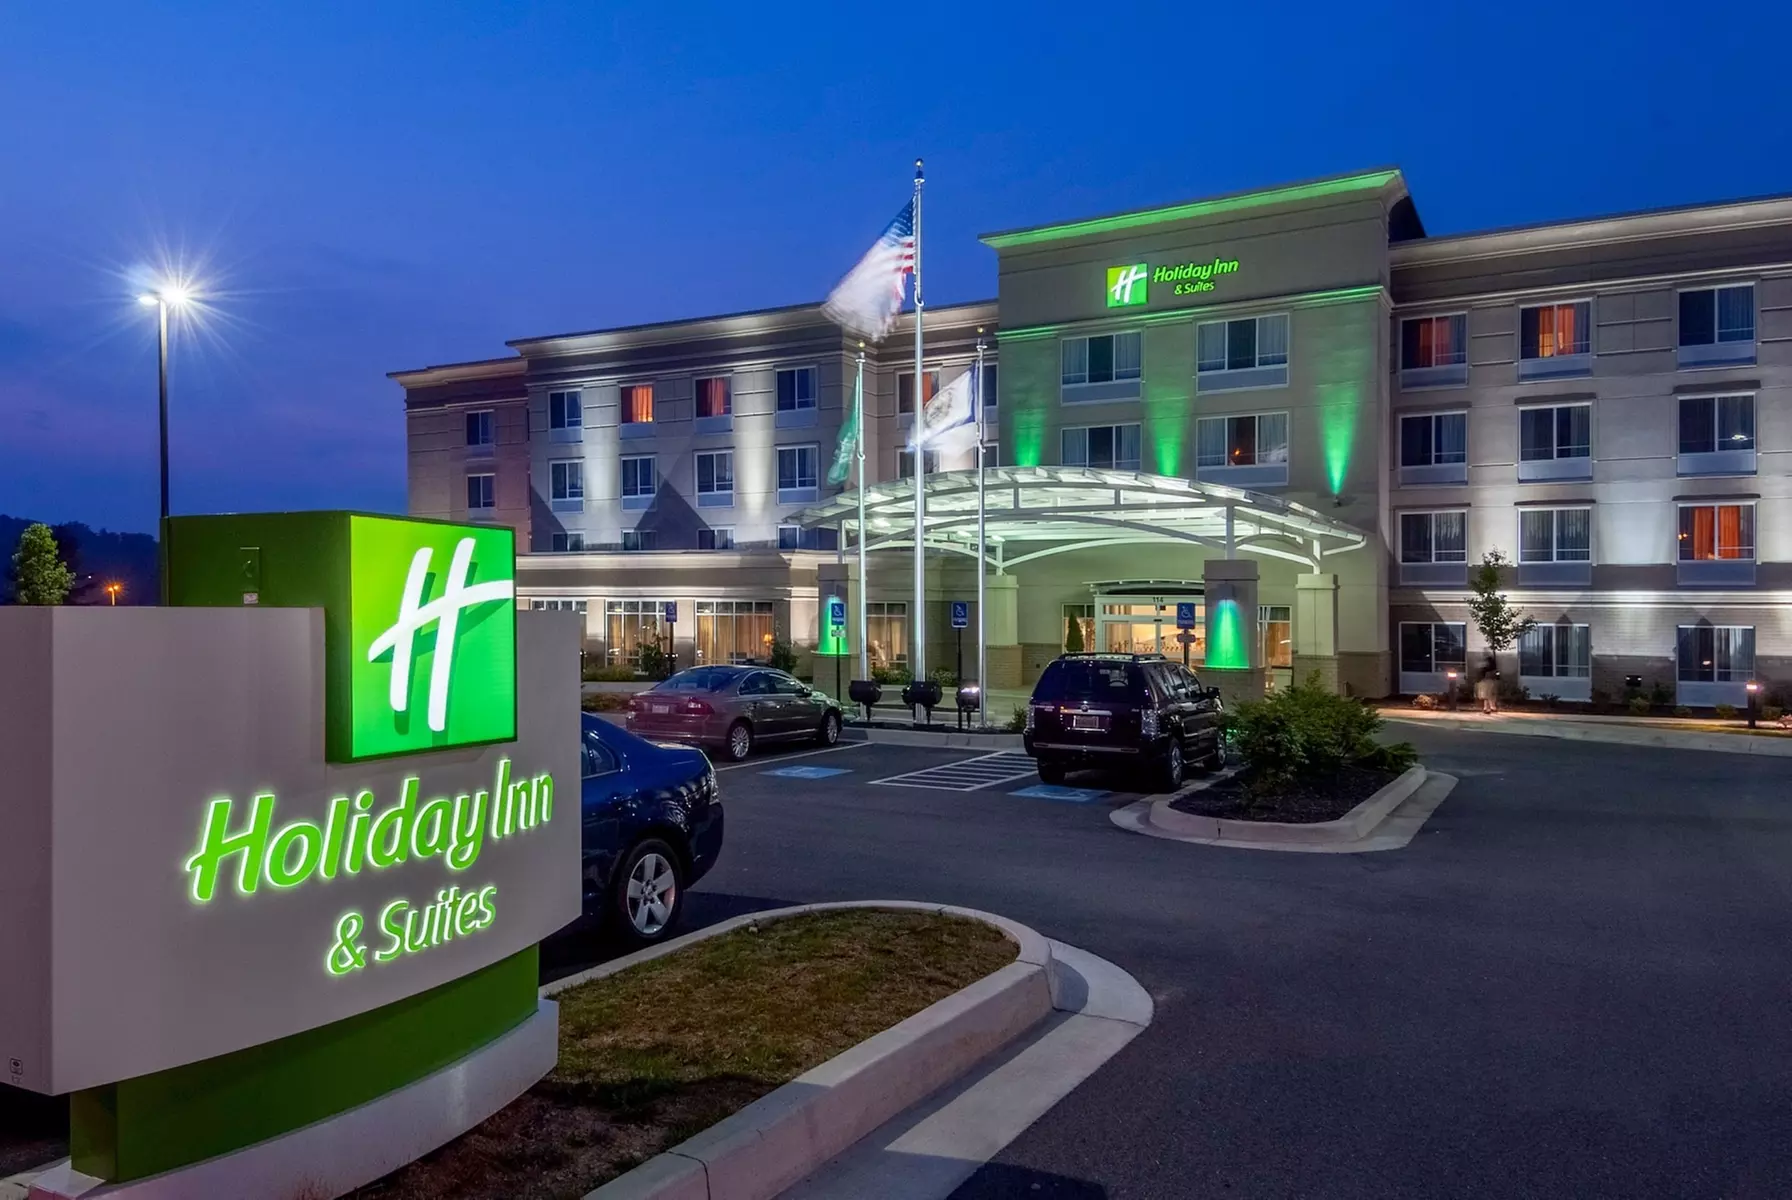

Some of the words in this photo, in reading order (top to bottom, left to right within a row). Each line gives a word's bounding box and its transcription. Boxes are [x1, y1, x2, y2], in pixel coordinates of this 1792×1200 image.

[1153, 262, 1212, 282] Holiday
[1213, 258, 1239, 275] Inn
[1174, 283, 1183, 295] &
[1184, 281, 1215, 294] Suites
[185, 776, 489, 901] Holiday
[491, 759, 554, 840] Inn
[326, 912, 367, 975] &
[374, 885, 497, 962] Suites
